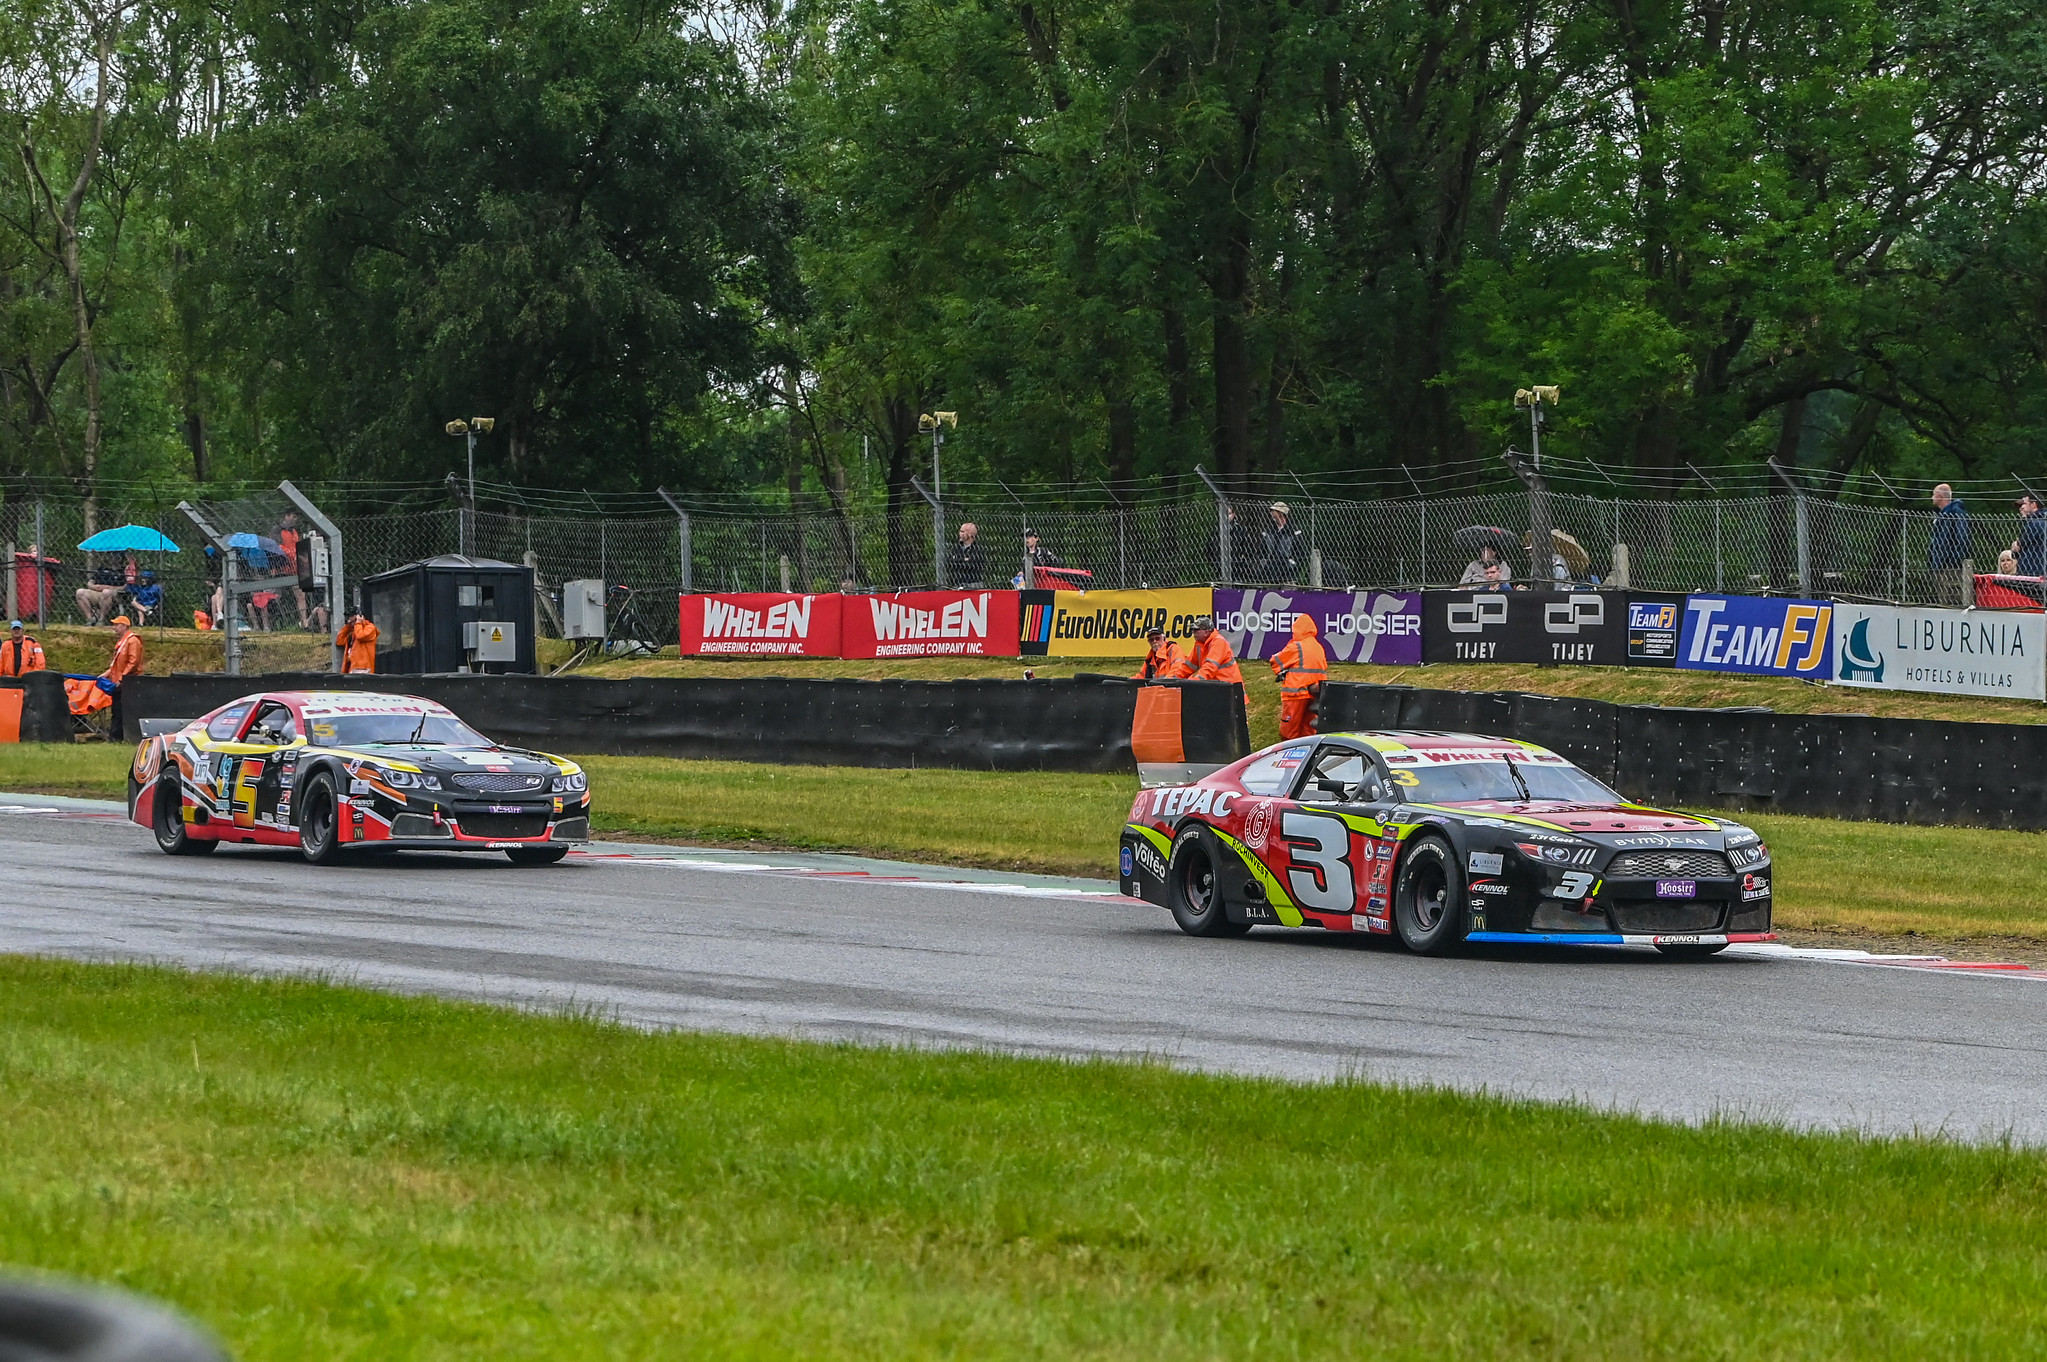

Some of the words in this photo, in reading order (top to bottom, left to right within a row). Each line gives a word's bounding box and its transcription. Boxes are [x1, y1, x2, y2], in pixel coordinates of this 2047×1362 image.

[704, 596, 812, 638] WHELEN
[869, 593, 988, 640] WHELEN
[1055, 608, 1211, 640] EuroNASCAR.co
[1325, 613, 1421, 636] HOOSIER
[700, 641, 749, 654] ENGINEERING
[750, 642, 788, 654] COMPANY
[789, 642, 804, 654] INC.
[1896, 618, 2024, 657] LIBURNIA
[876, 644, 925, 656] ENGINEERING
[926, 643, 965, 655] COMPANY
[966, 642, 984, 654] INC.
[1456, 642, 1497, 659] TIJEY
[1552, 643, 1595, 661] TIJEY
[1906, 667, 1957, 684] HOTELS
[1957, 672, 1965, 685] &
[1970, 672, 2013, 688] VILLAS
[314, 724, 335, 737] 5
[1421, 752, 1531, 763] WHELEN
[1390, 769, 1420, 787] 3
[233, 757, 266, 831] 5
[1151, 787, 1244, 817] TEPAC
[553, 797, 564, 813] 5
[1134, 842, 1166, 878] Voltéo
[1231, 839, 1269, 878] ROCHINVEST
[1283, 812, 1355, 912] 3
[1472, 884, 1508, 892] KENNOL
[1552, 871, 1594, 899] 3
[1658, 882, 1693, 895] Hoosier
[1246, 908, 1270, 918] B.L.A.
